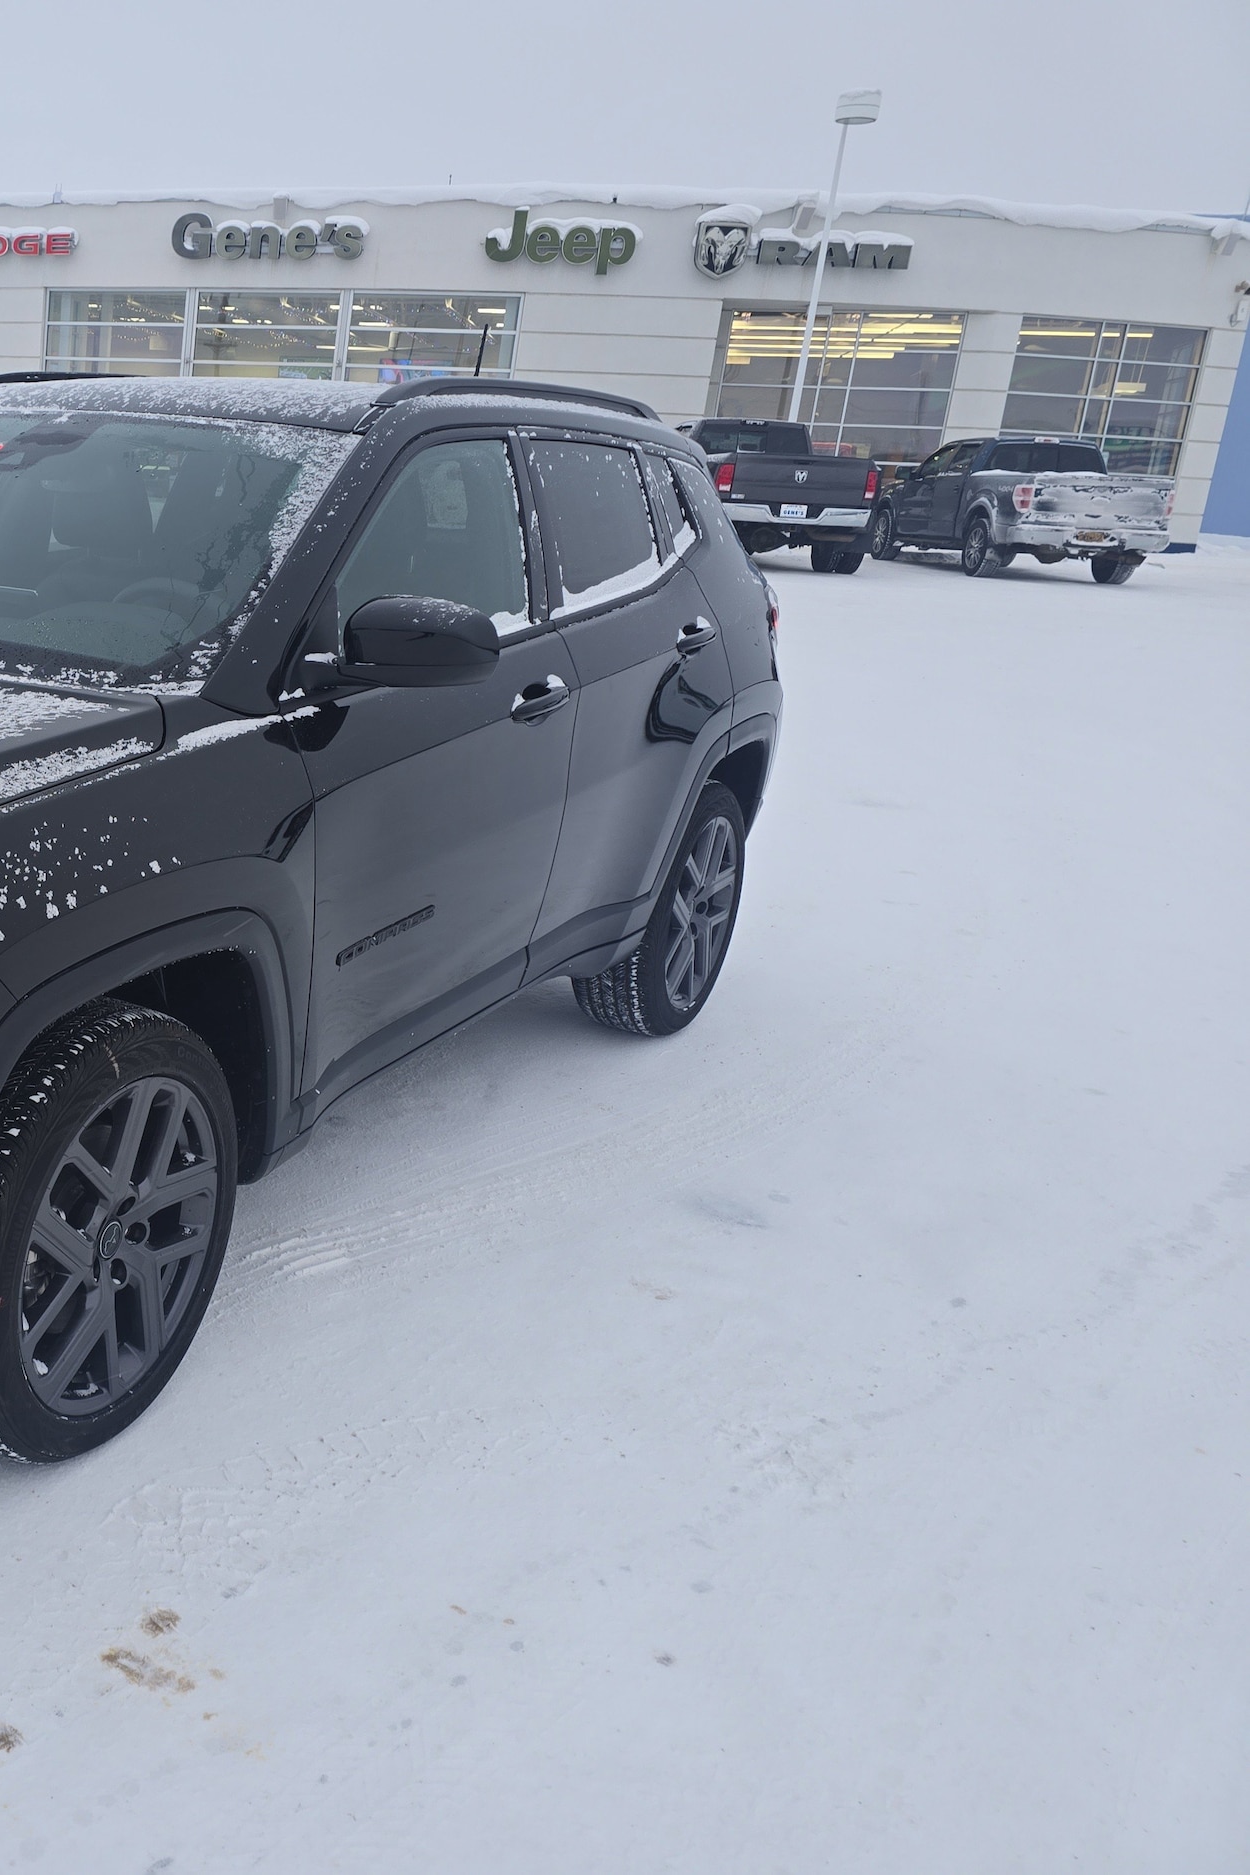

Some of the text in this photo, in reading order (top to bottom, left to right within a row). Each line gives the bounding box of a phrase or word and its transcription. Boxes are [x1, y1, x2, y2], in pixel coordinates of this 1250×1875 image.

[171, 212, 365, 260] Gene's
[484, 207, 637, 275] Jeep
[756, 238, 915, 270] RAM
